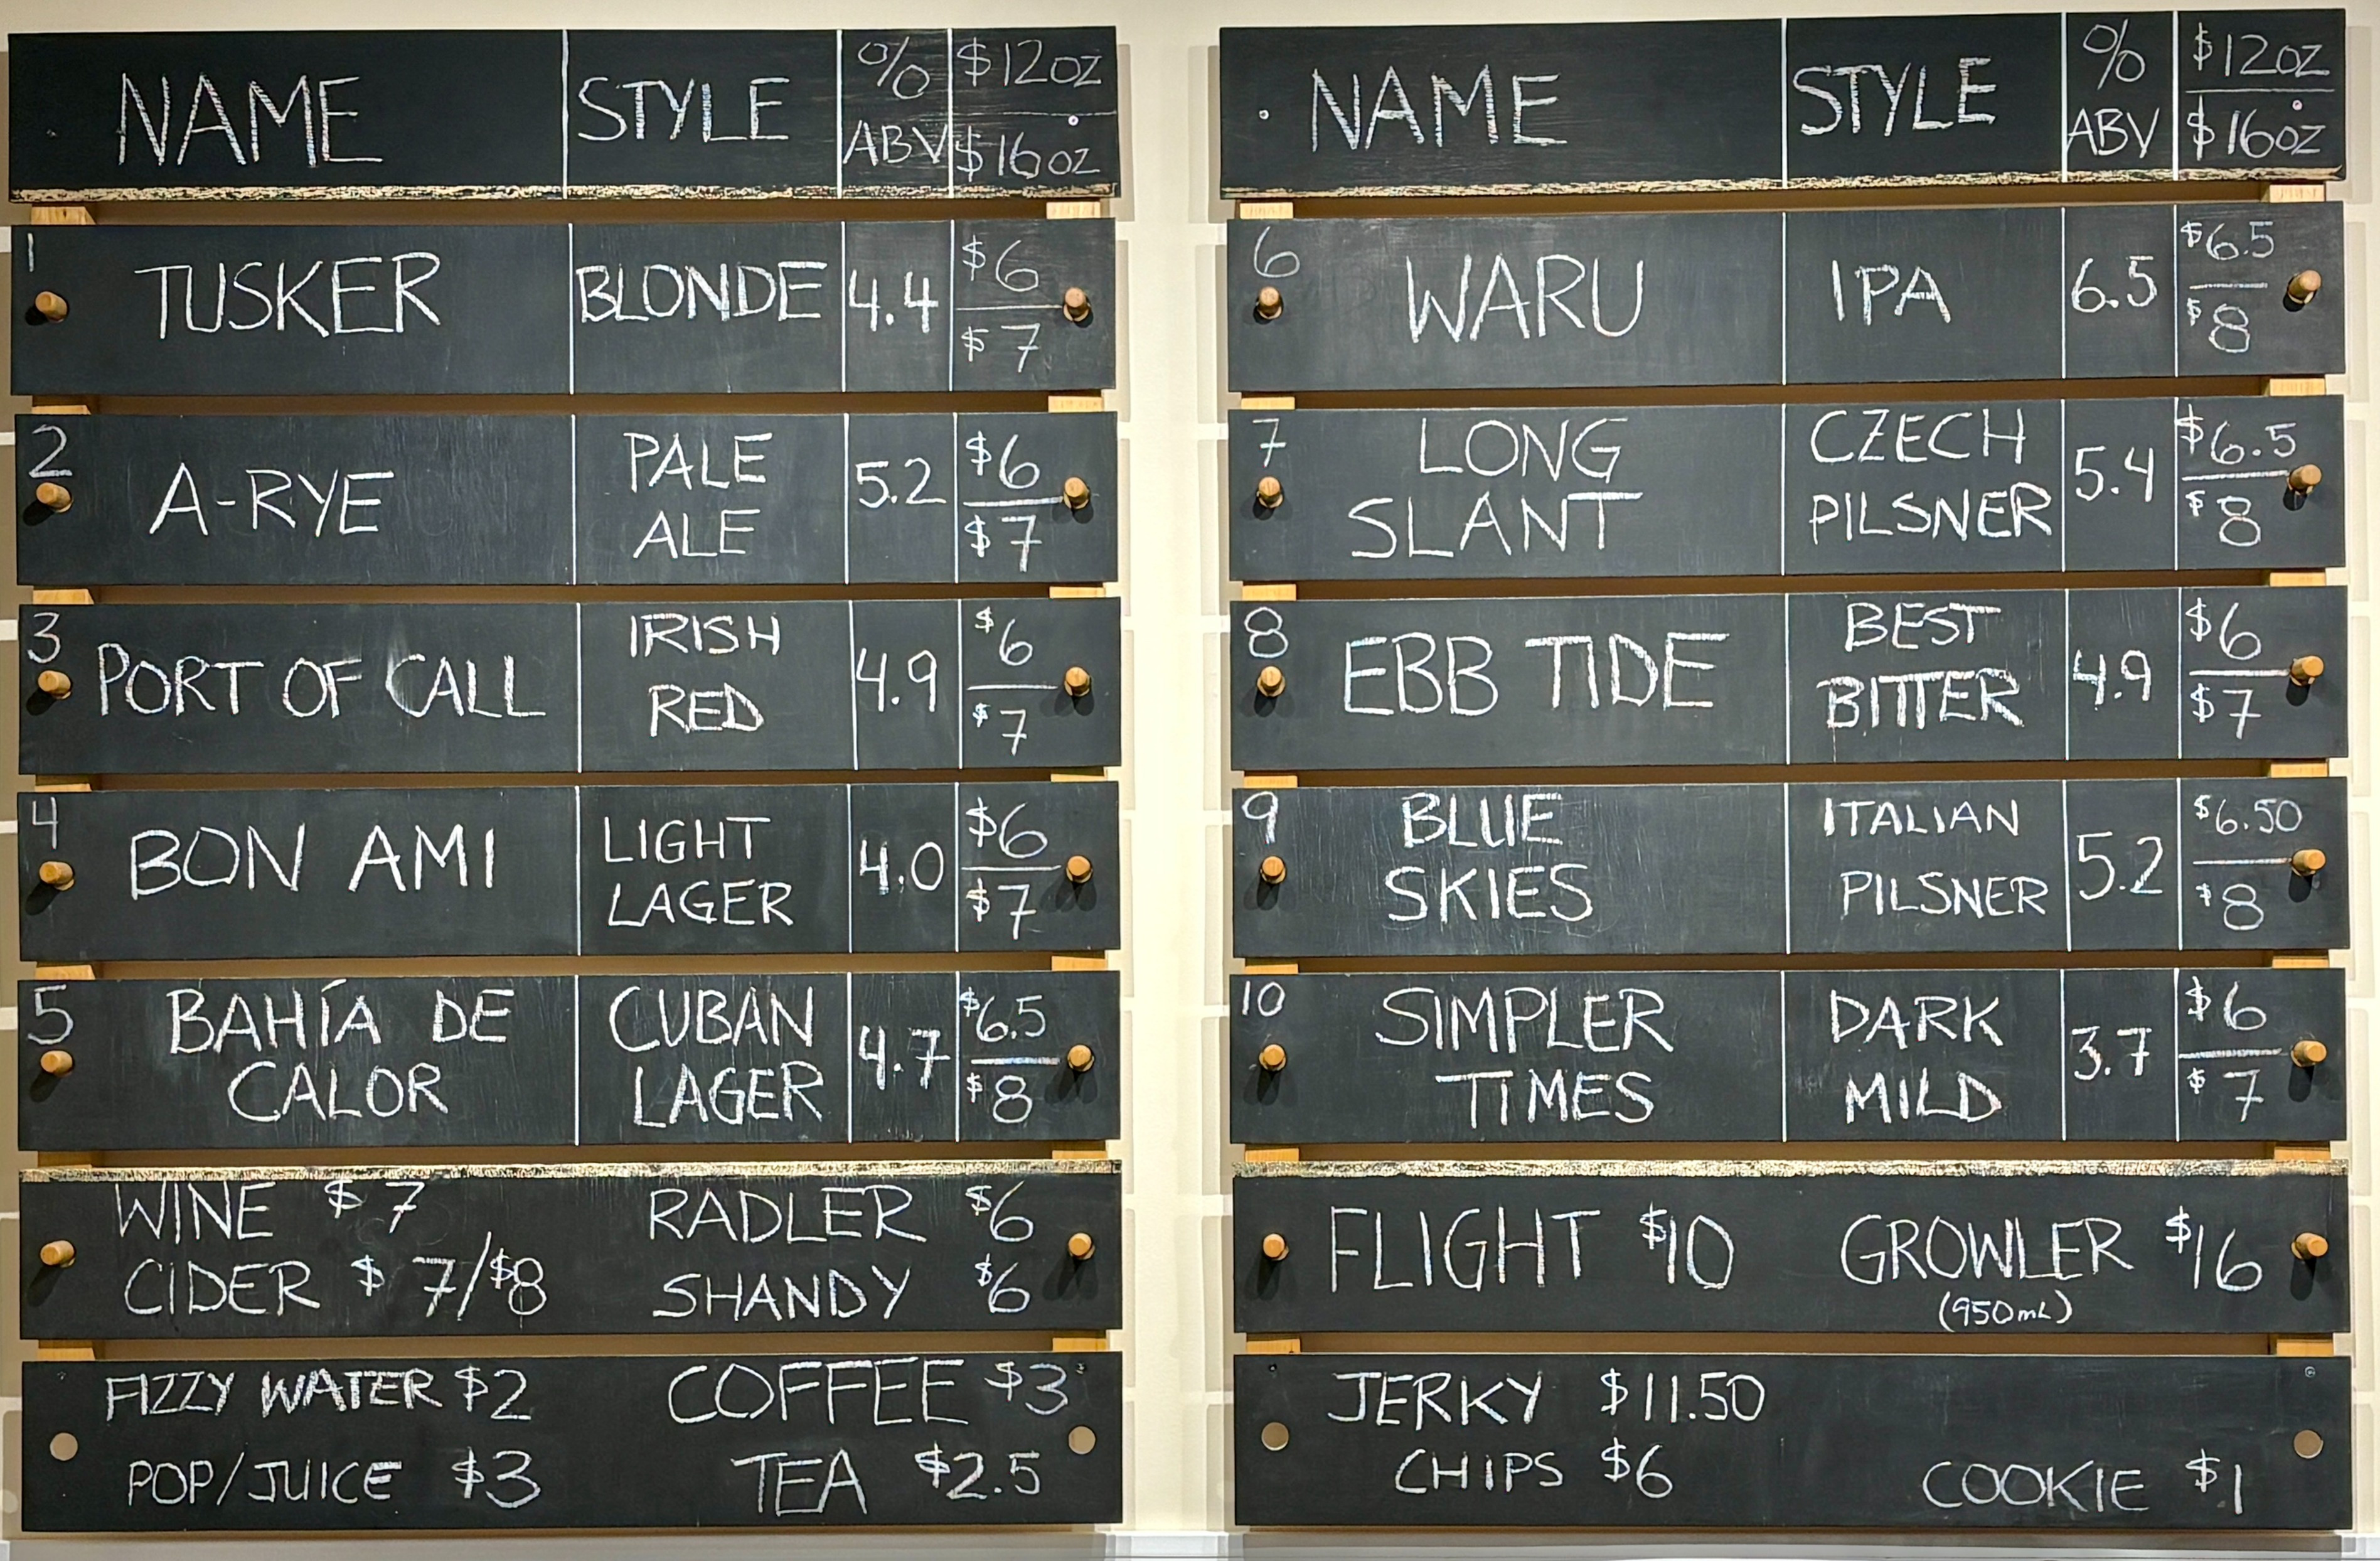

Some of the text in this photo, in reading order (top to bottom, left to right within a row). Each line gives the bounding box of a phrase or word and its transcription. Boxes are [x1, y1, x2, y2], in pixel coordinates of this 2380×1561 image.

[857, 36, 931, 100] %
[2083, 19, 2146, 90] %
[117, 72, 383, 167] NAME
[577, 77, 789, 142] STYLE
[1311, 64, 1567, 152] NAME
[1793, 56, 1996, 137] STYLE
[843, 119, 948, 166] ABV
[2067, 108, 2160, 158] ABV
[28, 232, 35, 272] 1
[961, 235, 1040, 292] $6
[1254, 226, 1300, 278] 6
[2181, 221, 2275, 261] $6.5
[134, 252, 440, 339] TUSKER
[576, 261, 827, 323] BLONDE
[848, 269, 939, 333] 4.4
[1406, 253, 1644, 343] WARU
[1832, 260, 1951, 326] IPA
[2071, 255, 2157, 313] 6.5
[2186, 299, 2251, 353] $8
[29, 424, 73, 478] 2
[624, 432, 772, 492] PALE
[965, 431, 1040, 489] $6
[1252, 418, 1286, 467] 7
[1419, 417, 1628, 483] LONG
[1811, 409, 2025, 465] CZECH
[2175, 404, 2298, 465] $6.5
[149, 462, 395, 536] A-RYE
[855, 458, 947, 509] 5.2
[2074, 446, 2154, 502] 5.4
[633, 509, 760, 559] ALE
[964, 515, 1042, 572] $7
[1347, 491, 1643, 558] SLANT
[1810, 482, 2052, 545] PILSNER
[2185, 490, 2261, 547] $8
[27, 612, 61, 663] 3
[630, 612, 781, 657] IRISH
[975, 607, 1033, 667] $6
[1244, 606, 1289, 659] 8
[1844, 601, 2002, 652] BEST
[2185, 598, 2261, 661] $6
[97, 642, 547, 719] PORT OF CALL
[855, 648, 937, 712] 4.9
[1343, 631, 1730, 716] EBB TIDE
[1816, 668, 2024, 729] BITTER
[2073, 650, 2152, 711] 4.9
[648, 683, 765, 737] RED
[973, 704, 1028, 755] $7
[2189, 684, 2261, 740] $7
[31, 797, 58, 850] 4
[604, 816, 771, 864] LIGHT
[968, 797, 1049, 860] $6
[1241, 791, 1279, 844] 9
[1401, 792, 1563, 849] BLUE
[1824, 797, 2020, 837] ITALIAN
[2194, 794, 2302, 835] $6.50
[131, 822, 494, 900] BON AMI
[2076, 832, 2164, 901] 5.2
[608, 879, 794, 927] LAGER
[966, 879, 1037, 940] $7
[1384, 862, 1594, 923] SKIES
[1840, 871, 2049, 918] PILSNER
[2197, 884, 2265, 931] $8
[28, 984, 75, 1046] 5
[167, 979, 515, 1056] BAHÍA DE
[608, 985, 815, 1053] CUBAN
[959, 986, 1047, 1043] $6.5
[1241, 980, 1286, 1017] 10
[1375, 986, 1674, 1055] SIMPLER
[1830, 989, 2004, 1049] DARK
[2185, 976, 2267, 1031] $6
[858, 1024, 951, 1090] 4.7
[2071, 1025, 2153, 1081] 3.7
[227, 1060, 449, 1122] CALOR
[633, 1059, 824, 1129] LAGER
[966, 1073, 1033, 1124] $8
[1436, 1068, 1655, 1130] TIMES
[1845, 1068, 2003, 1125] MILD
[2187, 1068, 2265, 1124] $7
[115, 1181, 277, 1244] WINE
[649, 1181, 1035, 1244] RADLER $6
[1330, 1201, 1735, 1293] FLIGHT $10
[1840, 1205, 2262, 1294] GROWLER $16
[125, 1258, 321, 1317] CIDER
[653, 1253, 1032, 1322] SHANDY $6
[105, 1364, 532, 1422] FIZZY WATER $2
[667, 1356, 1070, 1425] COFFEE $3
[1326, 1368, 1766, 1431] JERKY $11.50
[127, 1447, 542, 1509] POP/JUICE $3
[730, 1442, 1041, 1518] TEA $2.5
[1394, 1437, 1673, 1499] CHIPS $6
[1922, 1449, 2244, 1516] COOKIE $1
